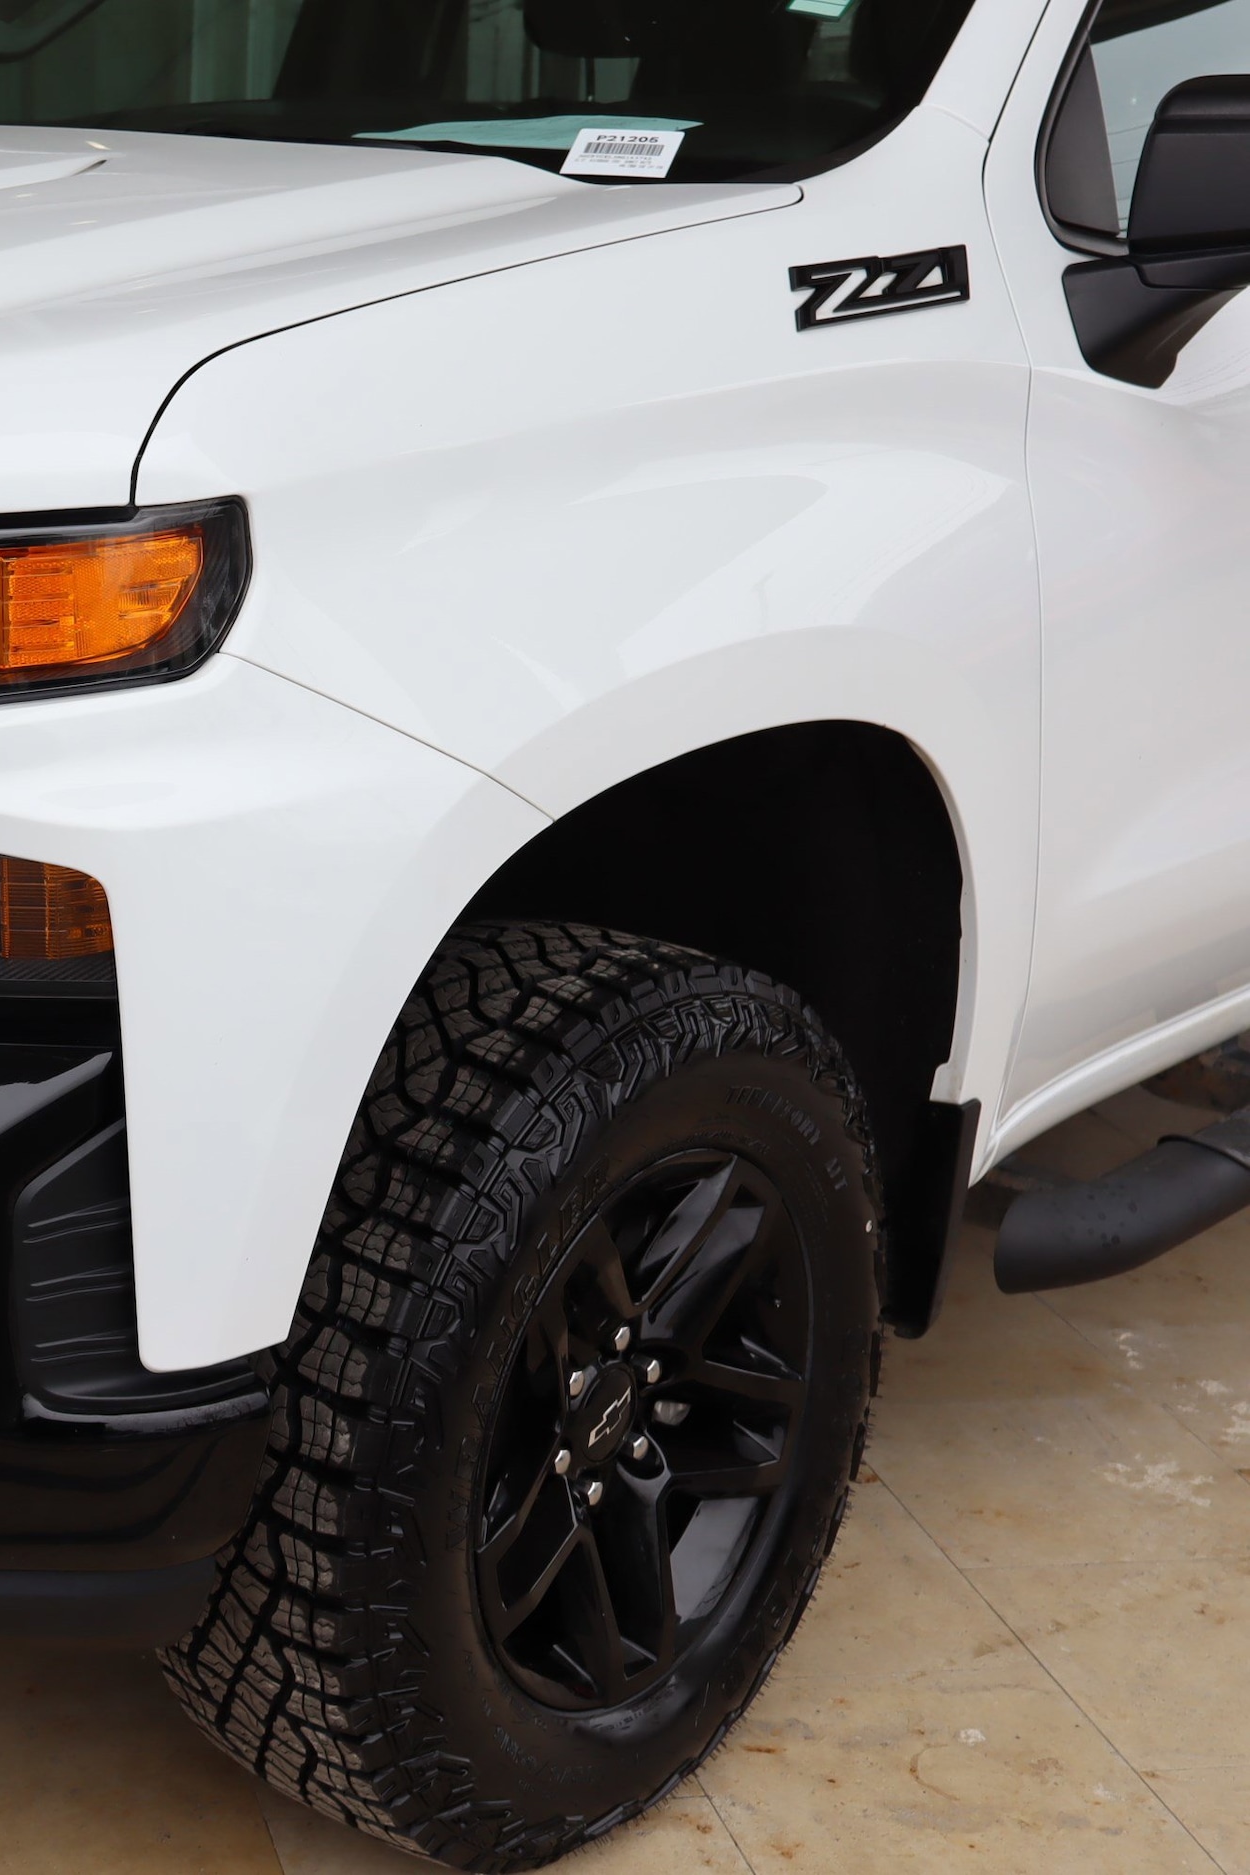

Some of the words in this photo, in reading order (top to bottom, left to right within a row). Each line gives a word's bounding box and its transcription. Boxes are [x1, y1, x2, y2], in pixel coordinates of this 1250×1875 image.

[596, 134, 661, 144] P21205
[788, 243, 970, 332] Z71
[724, 1085, 822, 1146] TERRITORY
[443, 1152, 612, 1554] WRANGLER
